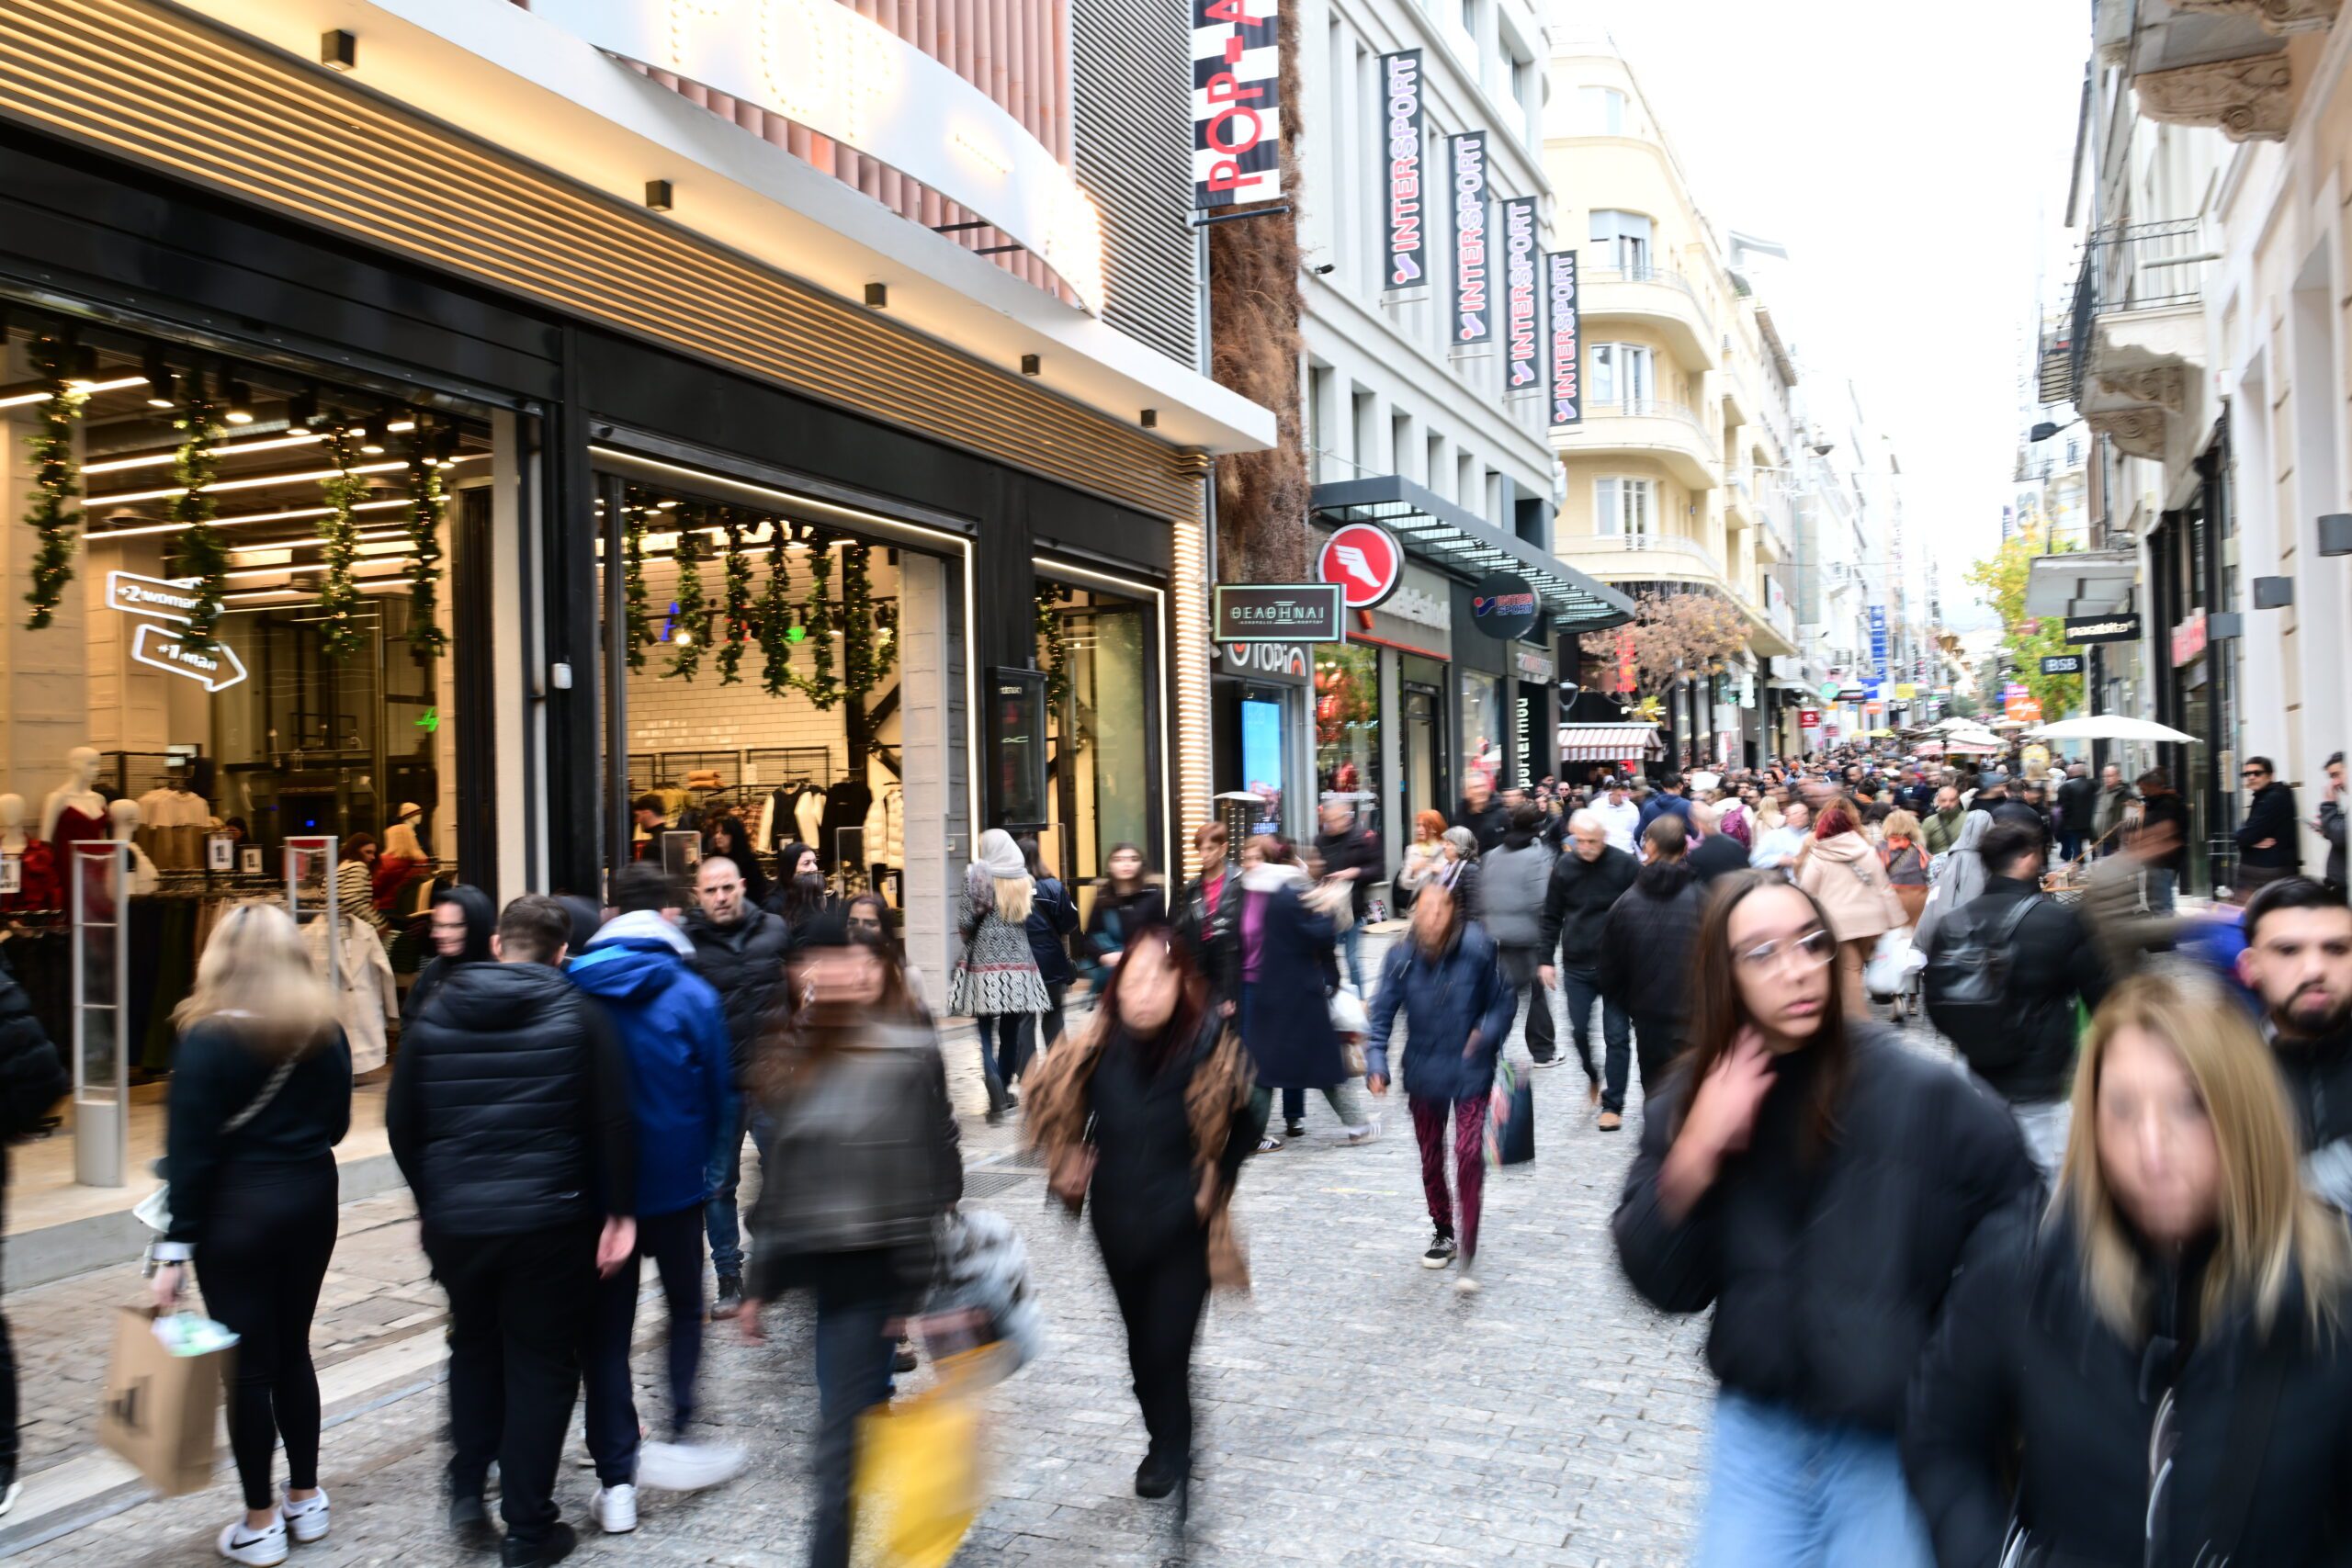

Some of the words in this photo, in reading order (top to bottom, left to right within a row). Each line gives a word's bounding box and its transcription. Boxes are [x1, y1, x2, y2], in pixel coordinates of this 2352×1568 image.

[1388, 55, 1420, 253] INTERSPORT
[1455, 136, 1486, 312] INTERSPORT
[1508, 202, 1534, 360] INTERSPORT
[1550, 254, 1576, 399] INTERSPORT
[1497, 592, 1533, 606] INTER
[1497, 603, 1533, 615] SPORT
[2045, 658, 2078, 671] BSB
